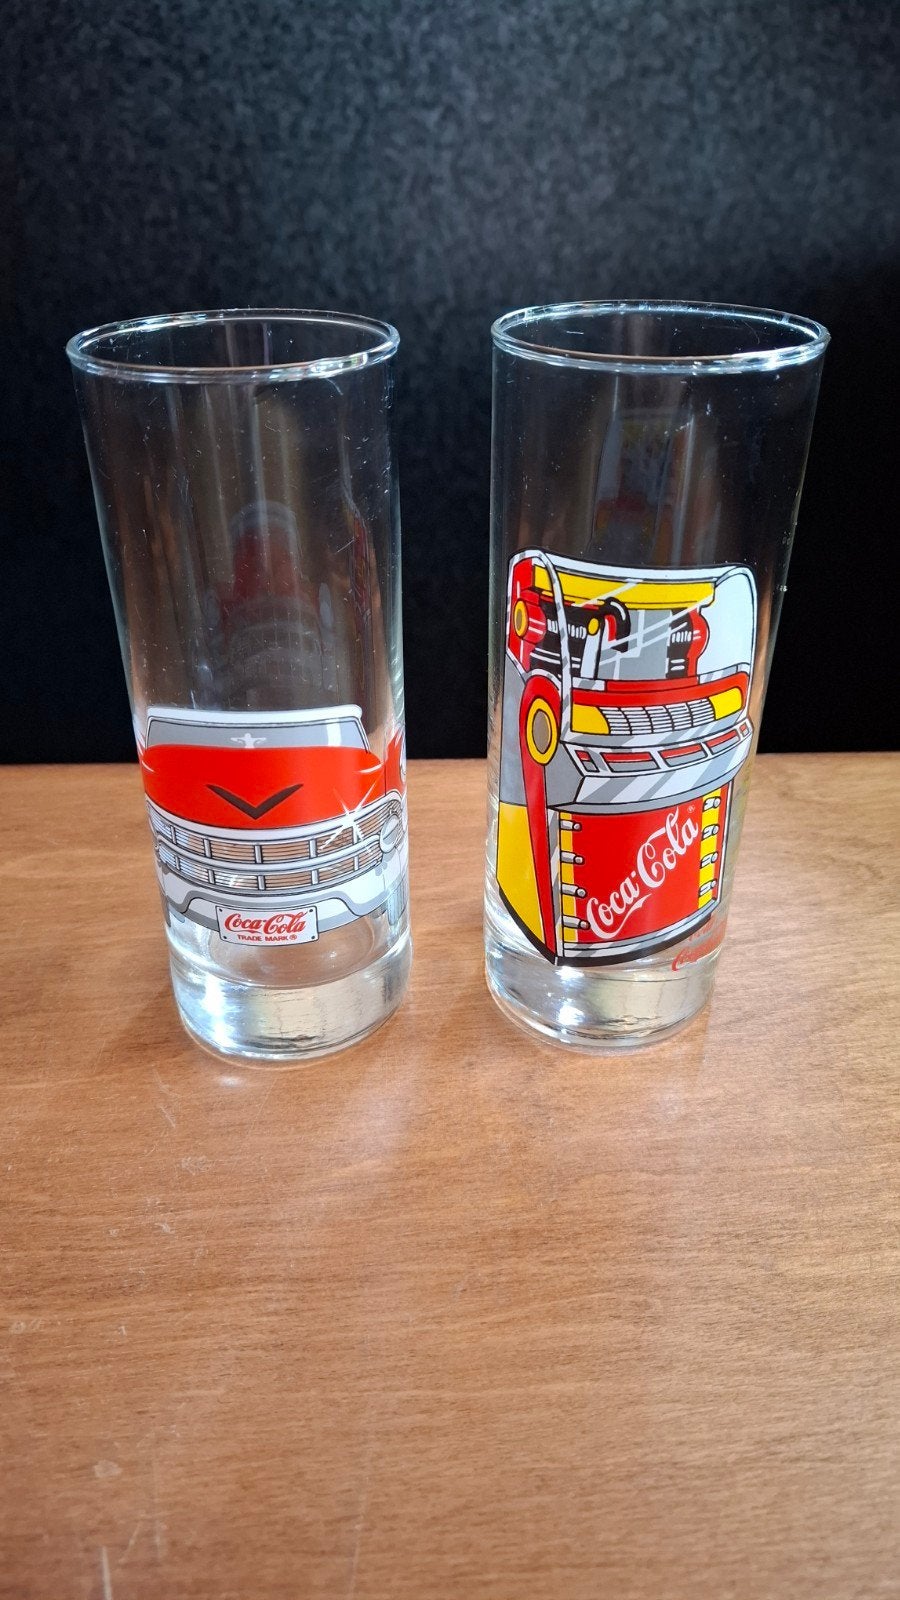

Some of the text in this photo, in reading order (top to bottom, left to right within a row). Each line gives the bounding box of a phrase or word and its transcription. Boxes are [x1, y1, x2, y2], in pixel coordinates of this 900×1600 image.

[586, 806, 699, 939] Coca-Cola
[224, 911, 308, 935] Coca-Cola
[237, 934, 262, 942] TRADE
